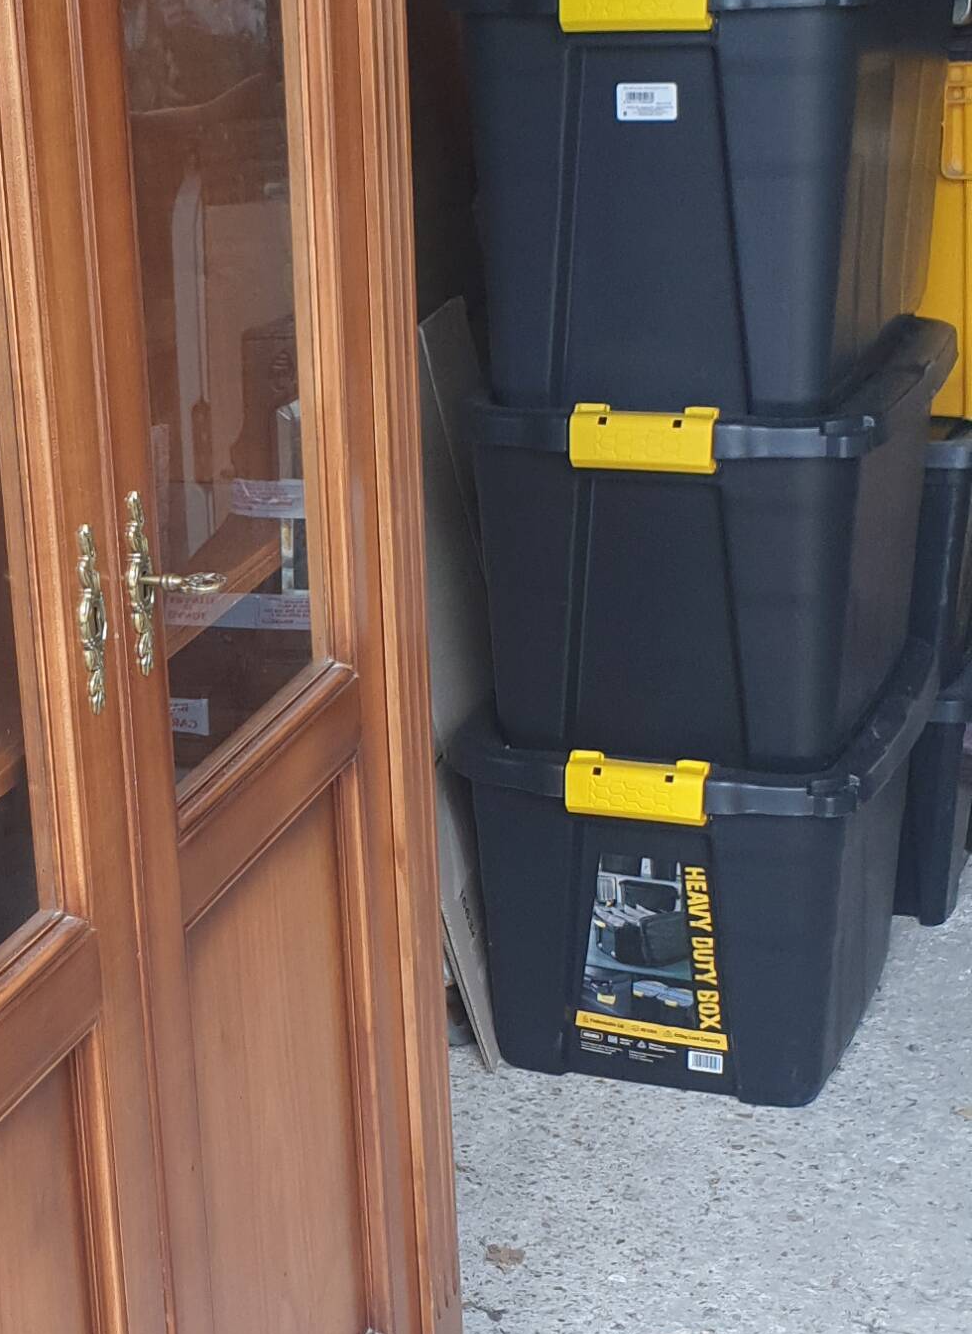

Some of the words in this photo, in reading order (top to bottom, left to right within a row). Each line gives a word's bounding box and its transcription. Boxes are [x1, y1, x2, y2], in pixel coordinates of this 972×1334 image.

[684, 866, 713, 933] HEAVY
[691, 936, 718, 987] DUTY
[696, 989, 722, 1030] BOX
